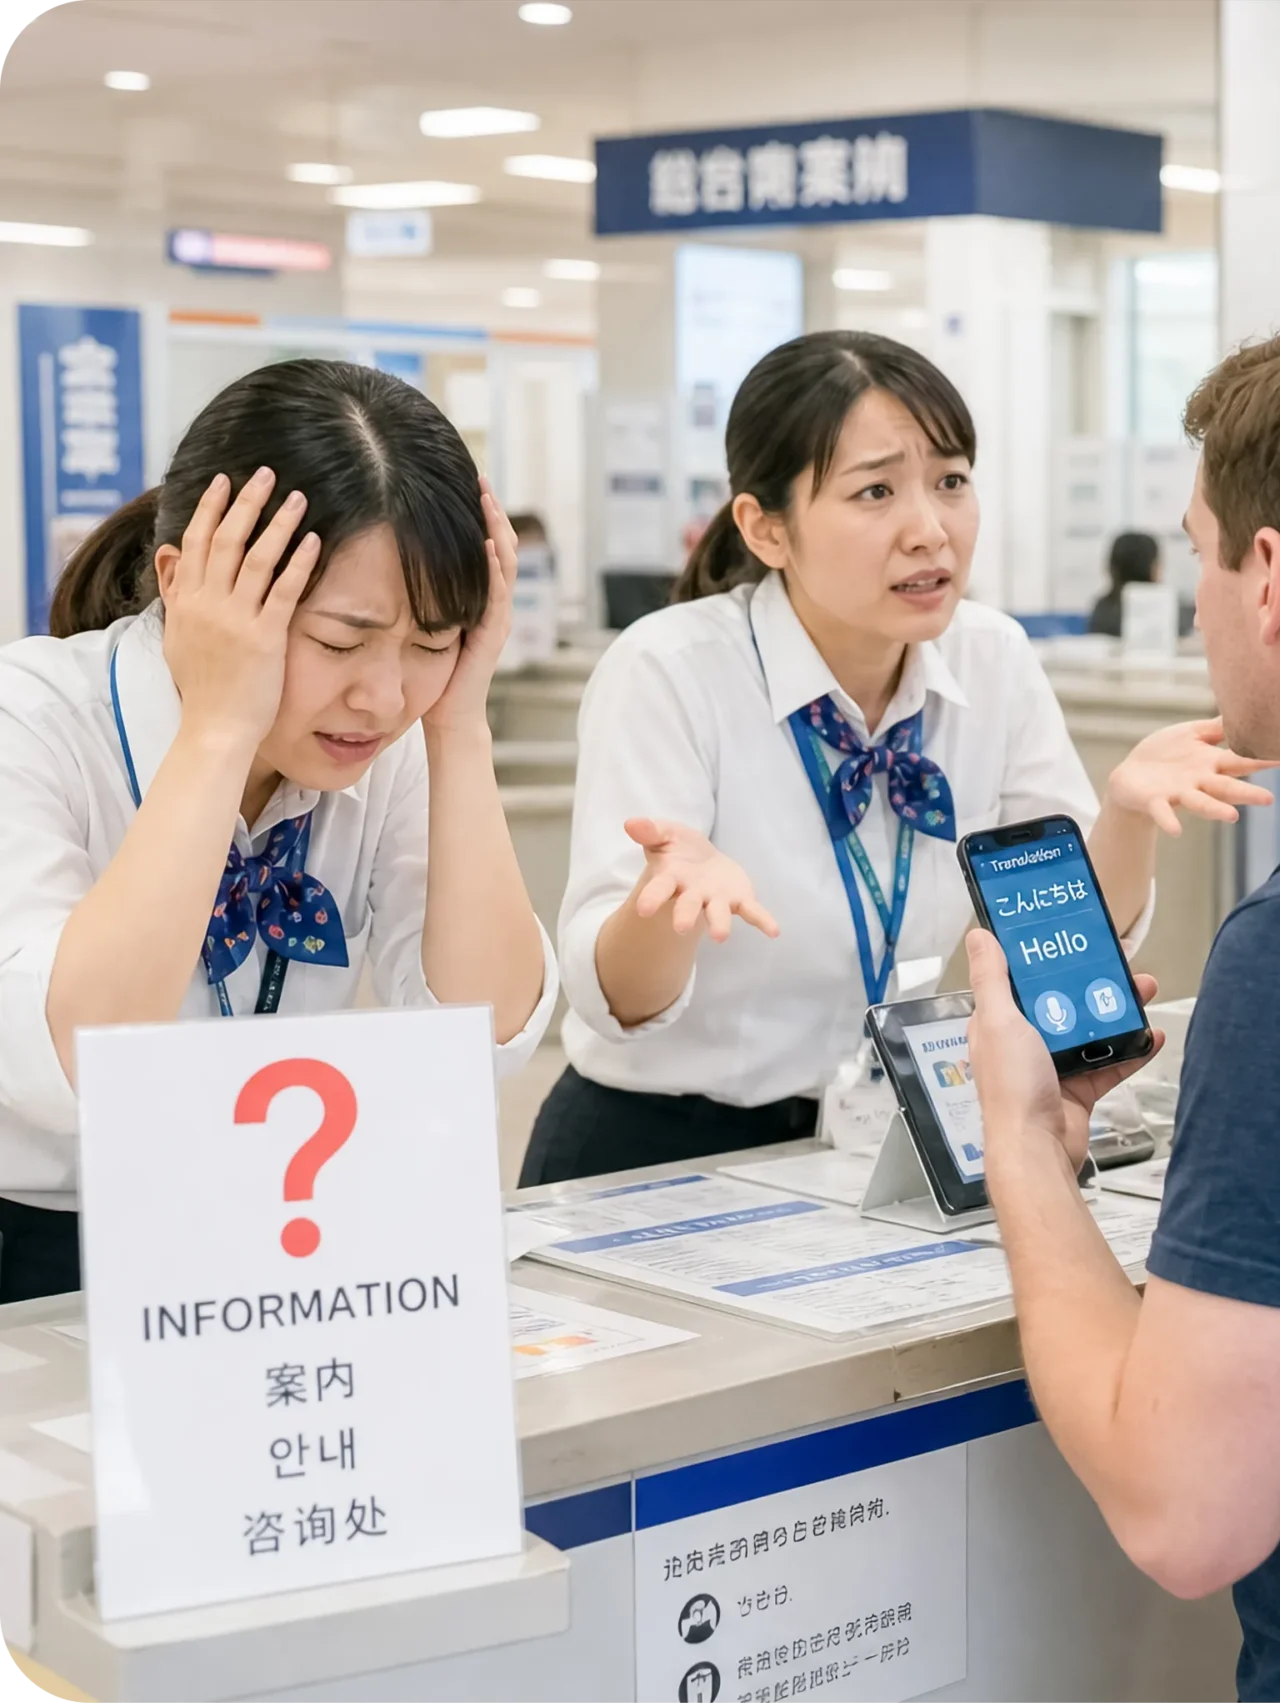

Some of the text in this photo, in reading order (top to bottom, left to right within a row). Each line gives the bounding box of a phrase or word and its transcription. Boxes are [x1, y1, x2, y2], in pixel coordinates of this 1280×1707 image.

[995, 879, 1089, 917] こんにちは
[1019, 929, 1088, 966] Hello
[142, 1273, 460, 1342] INFORMATION
[265, 1356, 354, 1408] 案内
[269, 1427, 357, 1480] 안내
[243, 1495, 388, 1557] 咨询处
